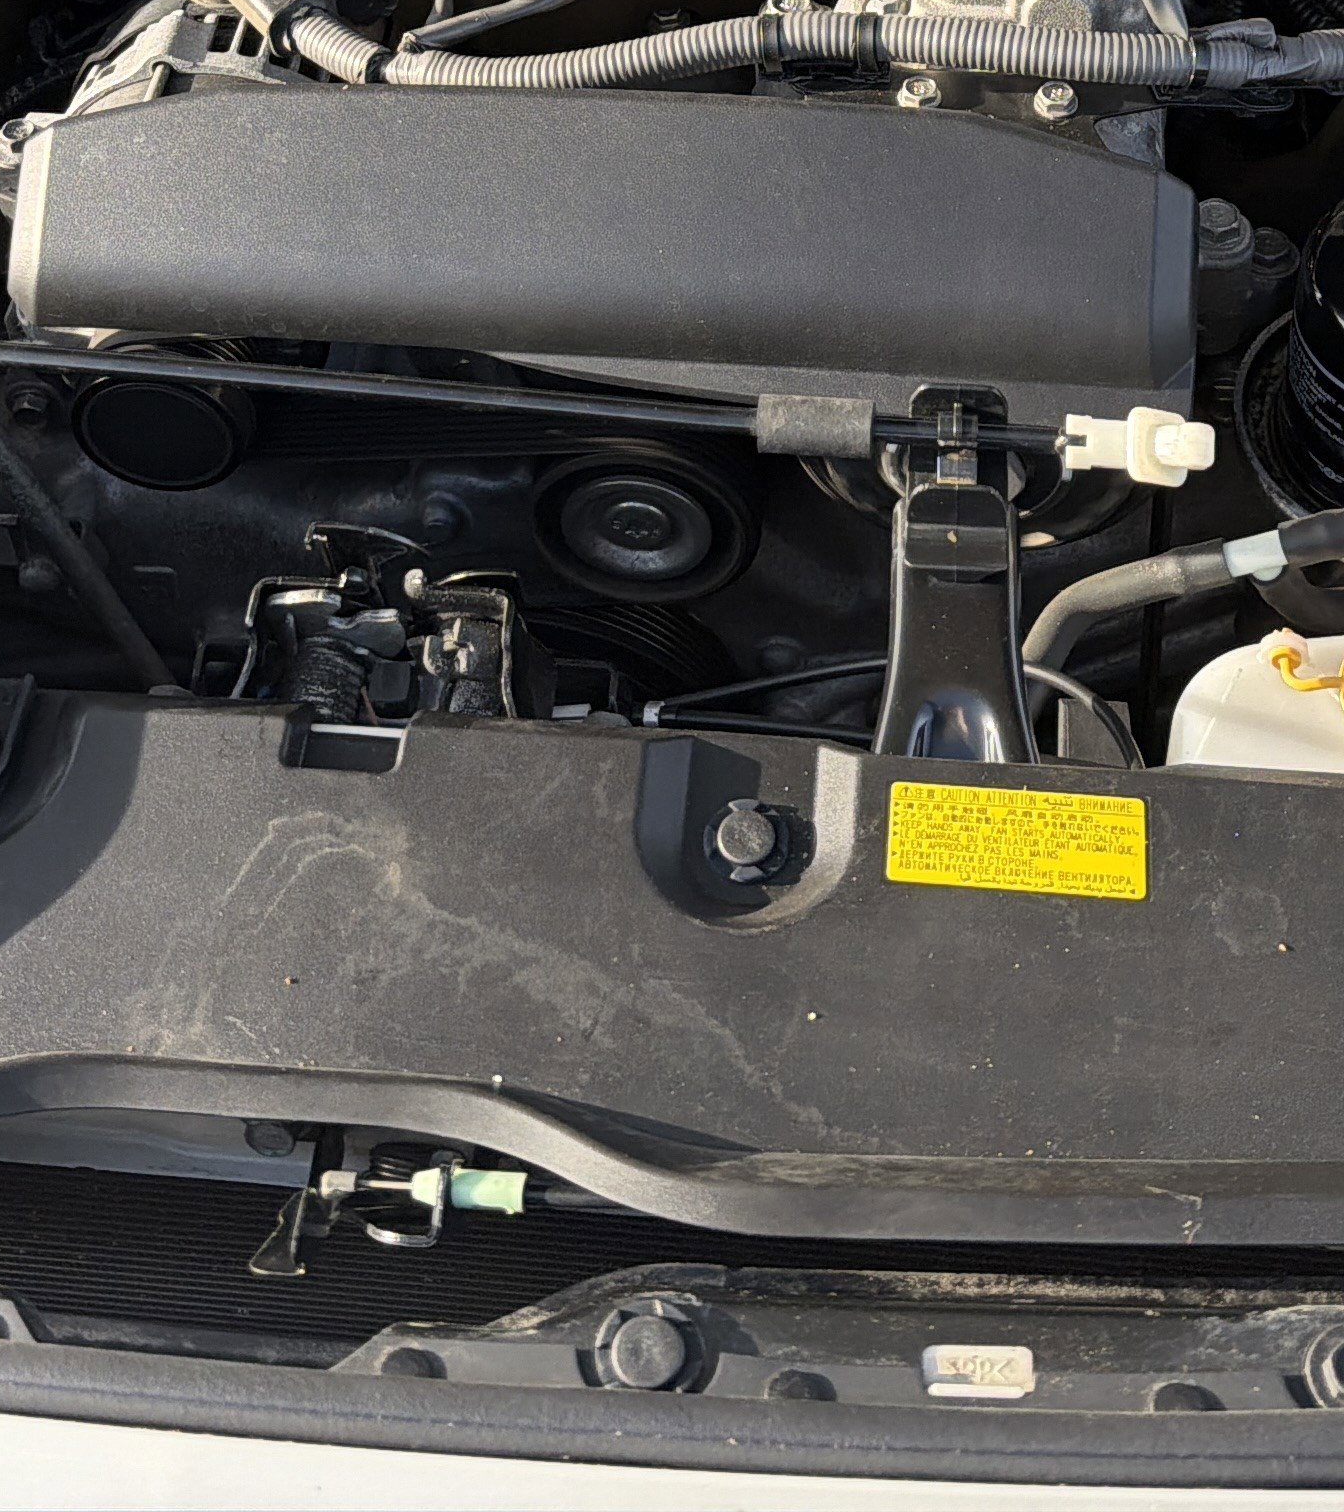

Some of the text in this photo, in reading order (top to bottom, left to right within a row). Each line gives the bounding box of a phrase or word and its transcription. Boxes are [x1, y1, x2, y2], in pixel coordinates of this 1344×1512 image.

[940, 789, 981, 803] CAUTION
[985, 791, 1037, 807] ATTENTION
[1078, 797, 1134, 814] ВНИМАНИЕ
[899, 829, 910, 839] LE
[966, 834, 978, 843] DU
[982, 835, 1040, 848] VENTILATEUR
[900, 819, 922, 829] KEEP
[926, 822, 954, 832] HANDS
[990, 826, 1008, 835] FAN
[1012, 828, 1045, 840] STARTS
[899, 848, 945, 862] ДЕРЖИТЕ
[948, 852, 975, 863] РУКИ
[927, 841, 979, 854] APPROCHEZ
[983, 845, 1002, 856] PAS
[1006, 847, 1025, 857] LES
[898, 859, 991, 876] АВТОМАТИЧЕСКОЕ
